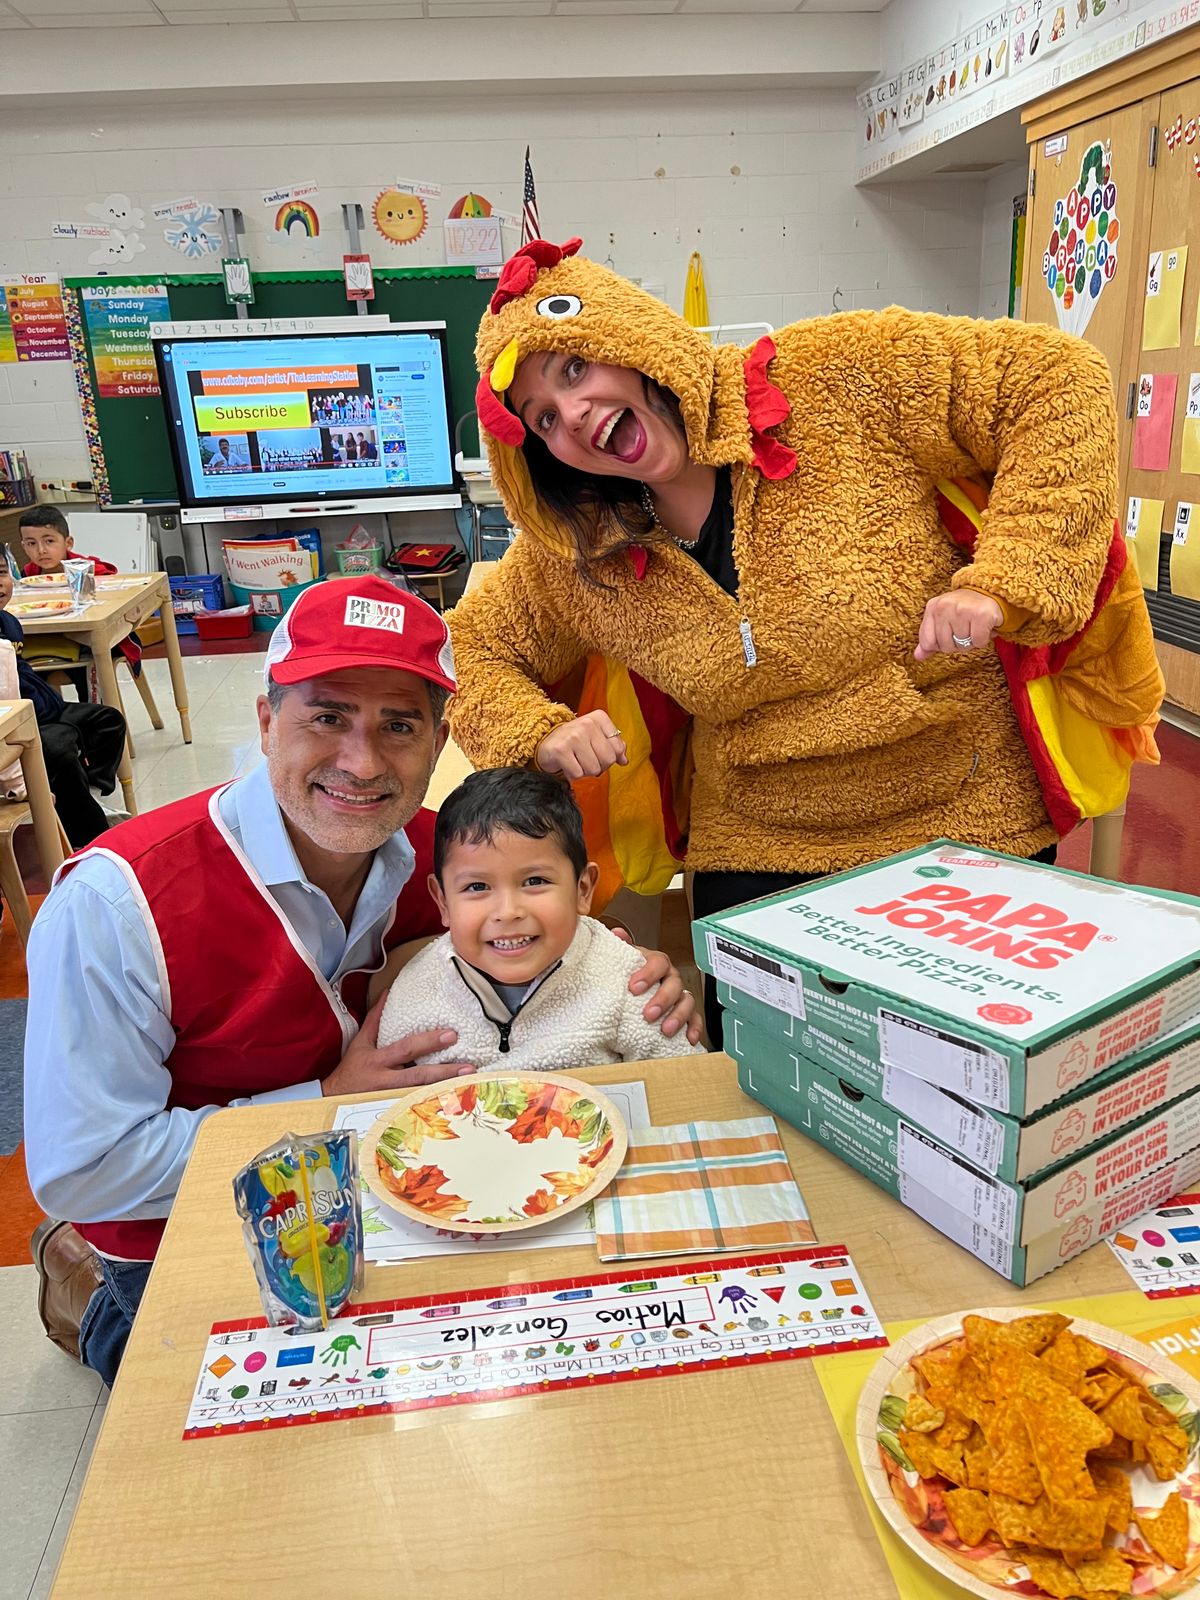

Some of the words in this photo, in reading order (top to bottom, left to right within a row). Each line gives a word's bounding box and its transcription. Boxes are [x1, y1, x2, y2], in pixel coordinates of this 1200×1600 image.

[1054, 189, 1115, 225] HAPPY
[53, 224, 78, 238] cloudy
[21, 275, 46, 284] Year
[1149, 279, 1158, 292] Gg
[22, 301, 48, 309] August
[108, 301, 144, 310] Sunday
[24, 313, 63, 321] September
[108, 315, 149, 325] Monday
[172, 325, 176, 335] 1
[186, 325, 193, 334] 2
[201, 324, 208, 334] 3
[215, 324, 222, 333] 4
[232, 323, 238, 332] 5
[247, 323, 253, 332] 6
[261, 322, 268, 332] 7
[290, 321, 296, 330] 9
[304, 320, 314, 330] 10
[122, 372, 153, 381] Friday
[202, 370, 358, 386] www.cdbaby.com/artist/TheLearningStation
[1139, 400, 1149, 411] Oo
[1189, 401, 1198, 415] Pp
[214, 405, 288, 420] Subscribe
[1175, 528, 1184, 540] Xx
[236, 560, 260, 570] Went
[261, 554, 304, 567] Walking
[351, 599, 401, 617] PRIMO
[350, 611, 398, 630] PIZZA
[940, 856, 969, 865] TEAM
[969, 859, 998, 868] PIZZA
[900, 883, 1100, 952] PAPA
[854, 899, 1074, 970] JOHNS
[785, 903, 875, 938] Better
[875, 933, 1064, 1003] Ingredients.
[803, 925, 899, 961] Better
[898, 959, 987, 996] Pizza.
[1099, 1015, 1128, 1038] DELIVER
[1129, 1007, 1144, 1020] OUR
[1096, 1038, 1111, 1052] GET
[1112, 1025, 1132, 1044] PAID
[1133, 1020, 1142, 1031] TO
[1144, 1008, 1162, 1026] SING
[1094, 1051, 1106, 1069] IN
[1108, 1034, 1138, 1063] YOUR
[1139, 1020, 1161, 1041] CAR
[1098, 1083, 1129, 1105] DELIVER
[1130, 1073, 1147, 1087] OUR
[1095, 1103, 1111, 1118] GET
[1113, 1092, 1133, 1109] PAID
[1135, 1085, 1145, 1096] TO
[1147, 1074, 1168, 1091] SING
[813, 1081, 842, 1106] DELIVERY
[842, 1099, 853, 1112] FEE
[861, 1112, 876, 1126] NOT
[883, 1125, 894, 1136] TIP
[1092, 1115, 1106, 1133] IN
[1109, 1099, 1140, 1124] YOUR
[1143, 1085, 1167, 1108] CAR
[1095, 1164, 1112, 1180] GET
[1113, 1152, 1133, 1173] PAID
[1135, 1145, 1145, 1157] TO
[1147, 1133, 1168, 1152] SING
[1096, 1144, 1128, 1167] DELIVER
[1128, 1135, 1144, 1149] OUR
[1094, 1178, 1108, 1197] IN
[1110, 1160, 1142, 1189] YOUR
[1144, 1145, 1168, 1169] CAR
[596, 1300, 686, 1329] Matias
[825, 1326, 845, 1336] Bb
[851, 1322, 870, 1332] Aa
[441, 1317, 568, 1351] Gonzalez
[752, 1335, 771, 1346] Ee
[778, 1331, 797, 1342] Dd
[803, 1329, 821, 1339] Cc
[673, 1345, 694, 1356] Hh
[700, 1339, 722, 1352] Gg
[729, 1338, 745, 1350] Ff
[610, 1353, 629, 1365] Kk
[635, 1347, 651, 1362] Jj
[658, 1348, 666, 1359] Ii
[554, 1360, 582, 1371] Mm
[589, 1357, 603, 1367] Ll
[443, 1373, 467, 1386] Qq
[501, 1368, 520, 1379] Oo
[323, 1392, 338, 1403] Vv
[370, 1386, 385, 1398] Tt
[227, 1401, 245, 1416] Yy
[255, 1401, 275, 1412] Xx
[285, 1396, 314, 1408] Ww
[199, 1408, 219, 1419] Zz
